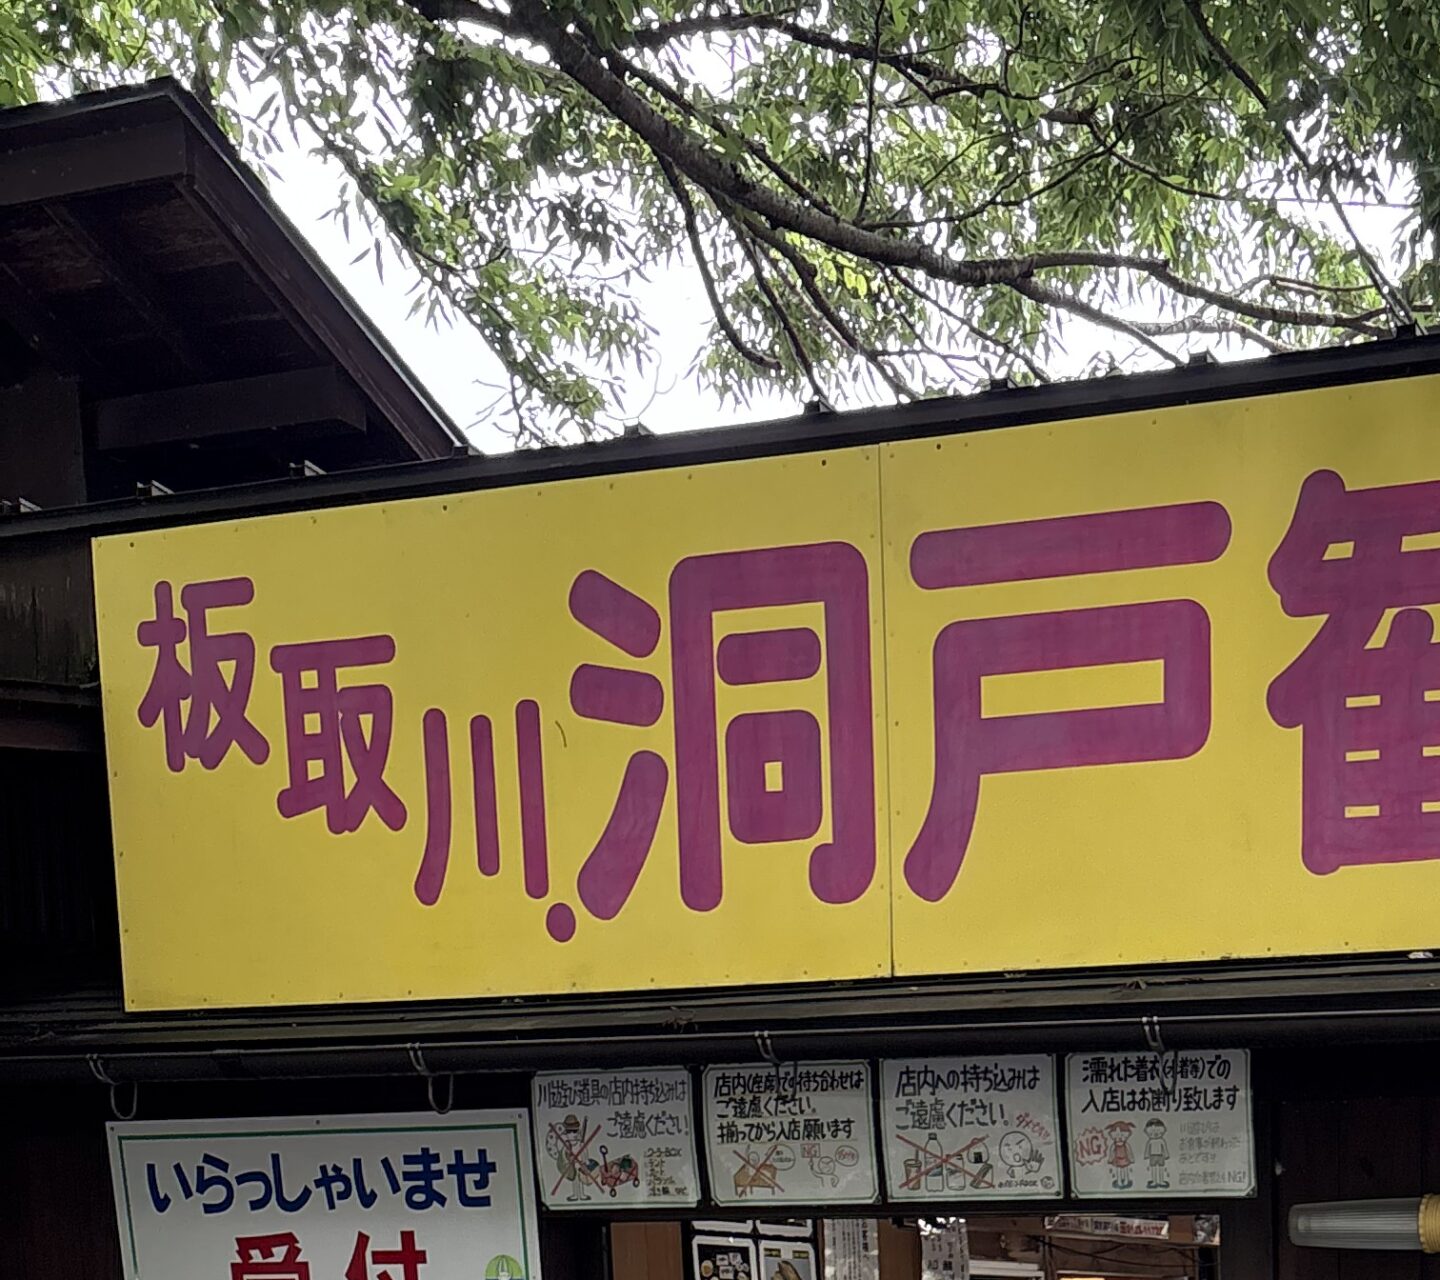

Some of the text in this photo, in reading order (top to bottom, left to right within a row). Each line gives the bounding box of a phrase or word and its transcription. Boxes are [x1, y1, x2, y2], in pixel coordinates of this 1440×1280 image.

[538, 1076, 687, 1108] 川遊び道具の店内持ち込みは
[895, 1063, 1040, 1097] 店内への持ち込みは
[1082, 1085, 1240, 1113] 入店はお断り致します
[716, 1118, 856, 1144] 揃ってから入店願います
[1079, 1136, 1101, 1158] NG
[146, 1147, 497, 1214] いらっしゃいませ
